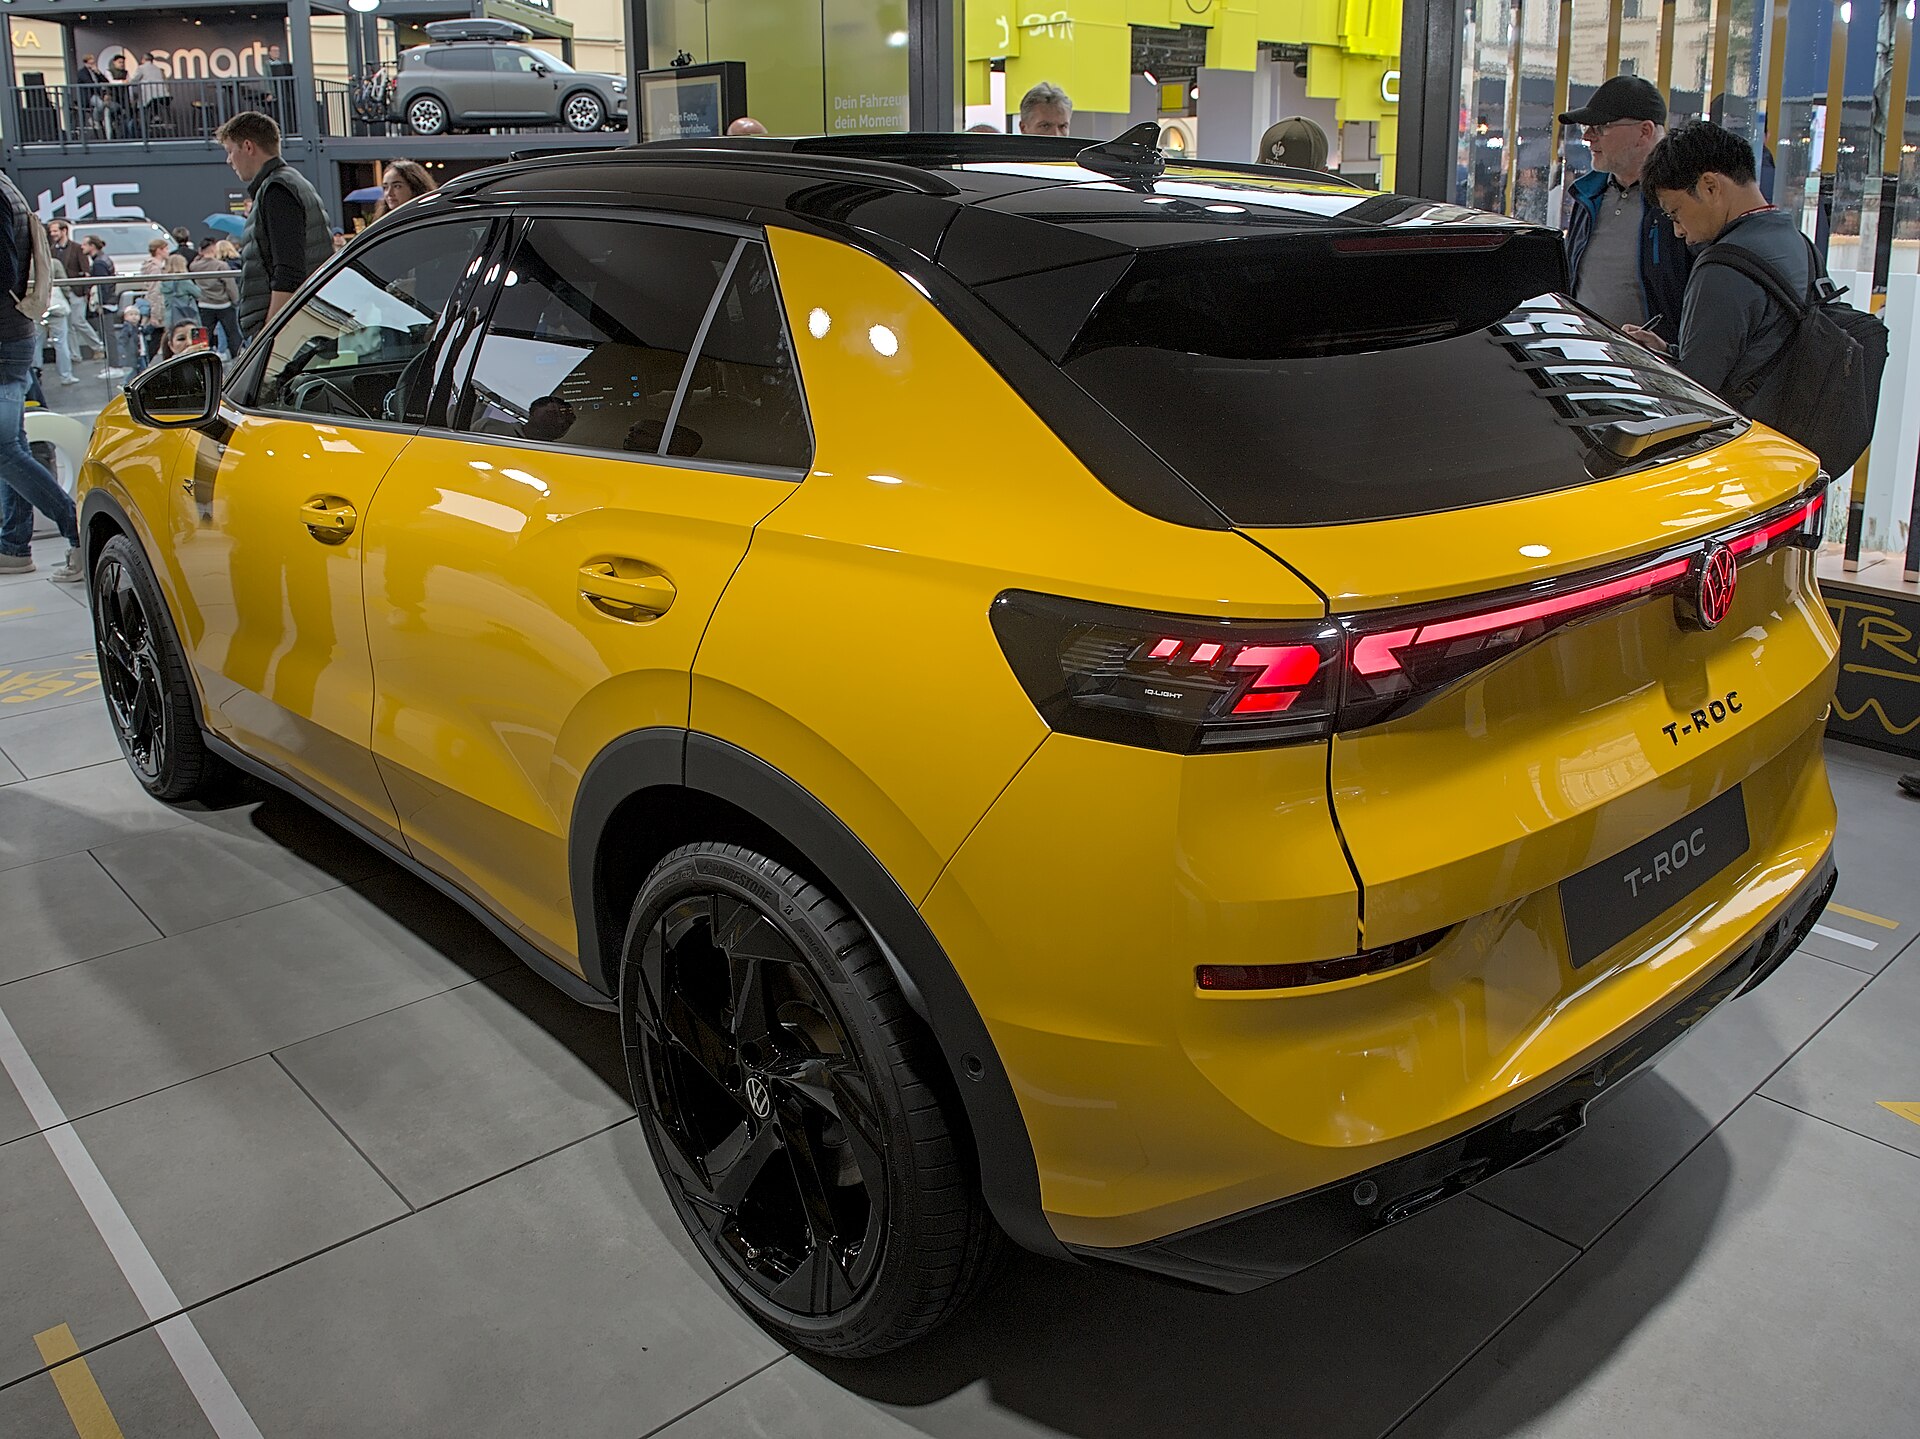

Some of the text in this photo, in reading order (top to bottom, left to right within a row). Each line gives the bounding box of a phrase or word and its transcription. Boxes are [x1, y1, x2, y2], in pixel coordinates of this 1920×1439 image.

[150, 41, 268, 80] smart
[834, 95, 857, 110] Dein
[835, 115, 857, 129] dein
[1825, 597, 1920, 664] TR
[1144, 688, 1183, 699] IQ.LIGHT
[1662, 691, 1743, 746] T-ROC
[1623, 827, 1706, 898] T-ROC
